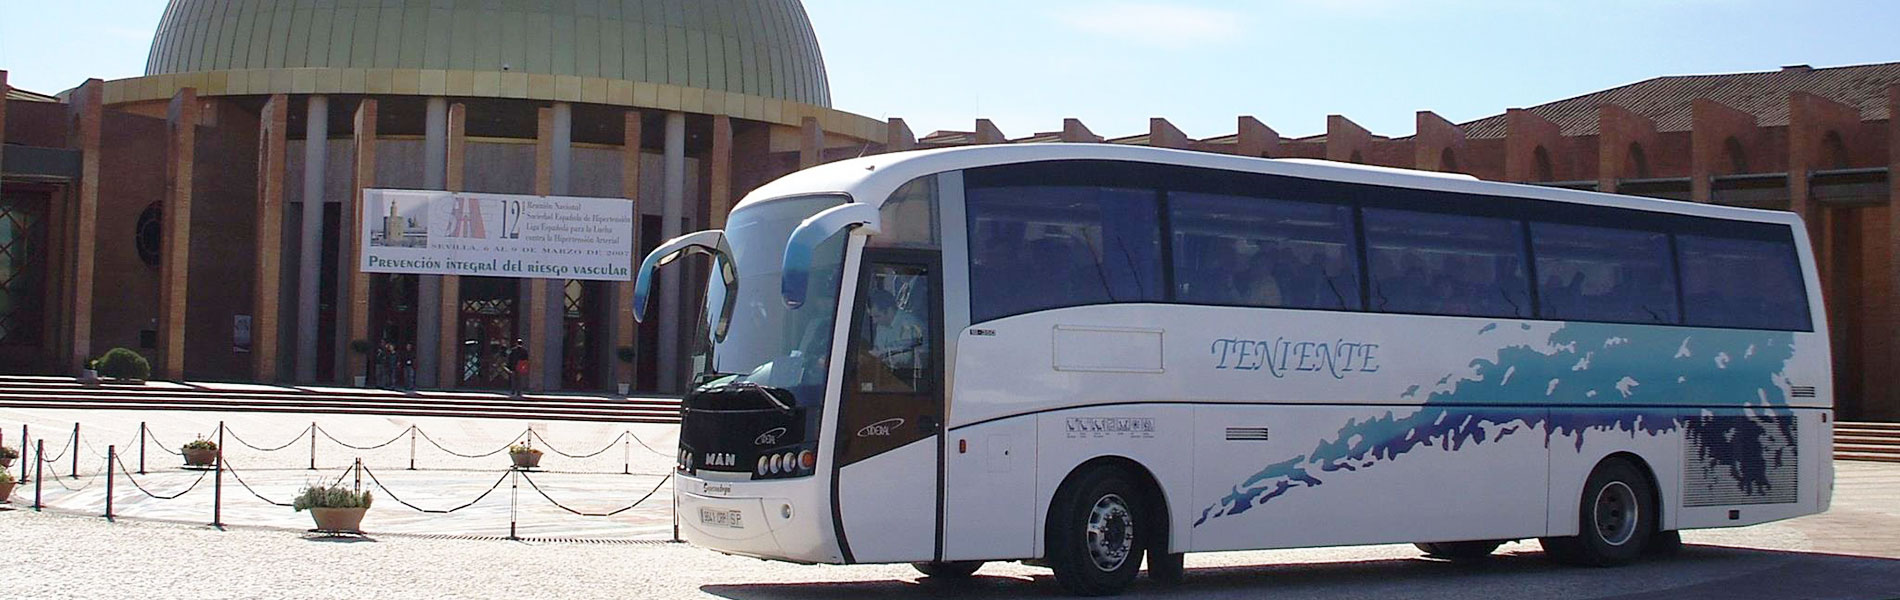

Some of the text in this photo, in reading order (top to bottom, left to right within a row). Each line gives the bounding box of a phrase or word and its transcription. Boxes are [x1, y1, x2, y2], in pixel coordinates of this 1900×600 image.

[500, 199, 521, 239] 12
[554, 202, 581, 210] Nacional
[1211, 336, 1380, 380] TENIENTE
[705, 452, 736, 466] MAN
